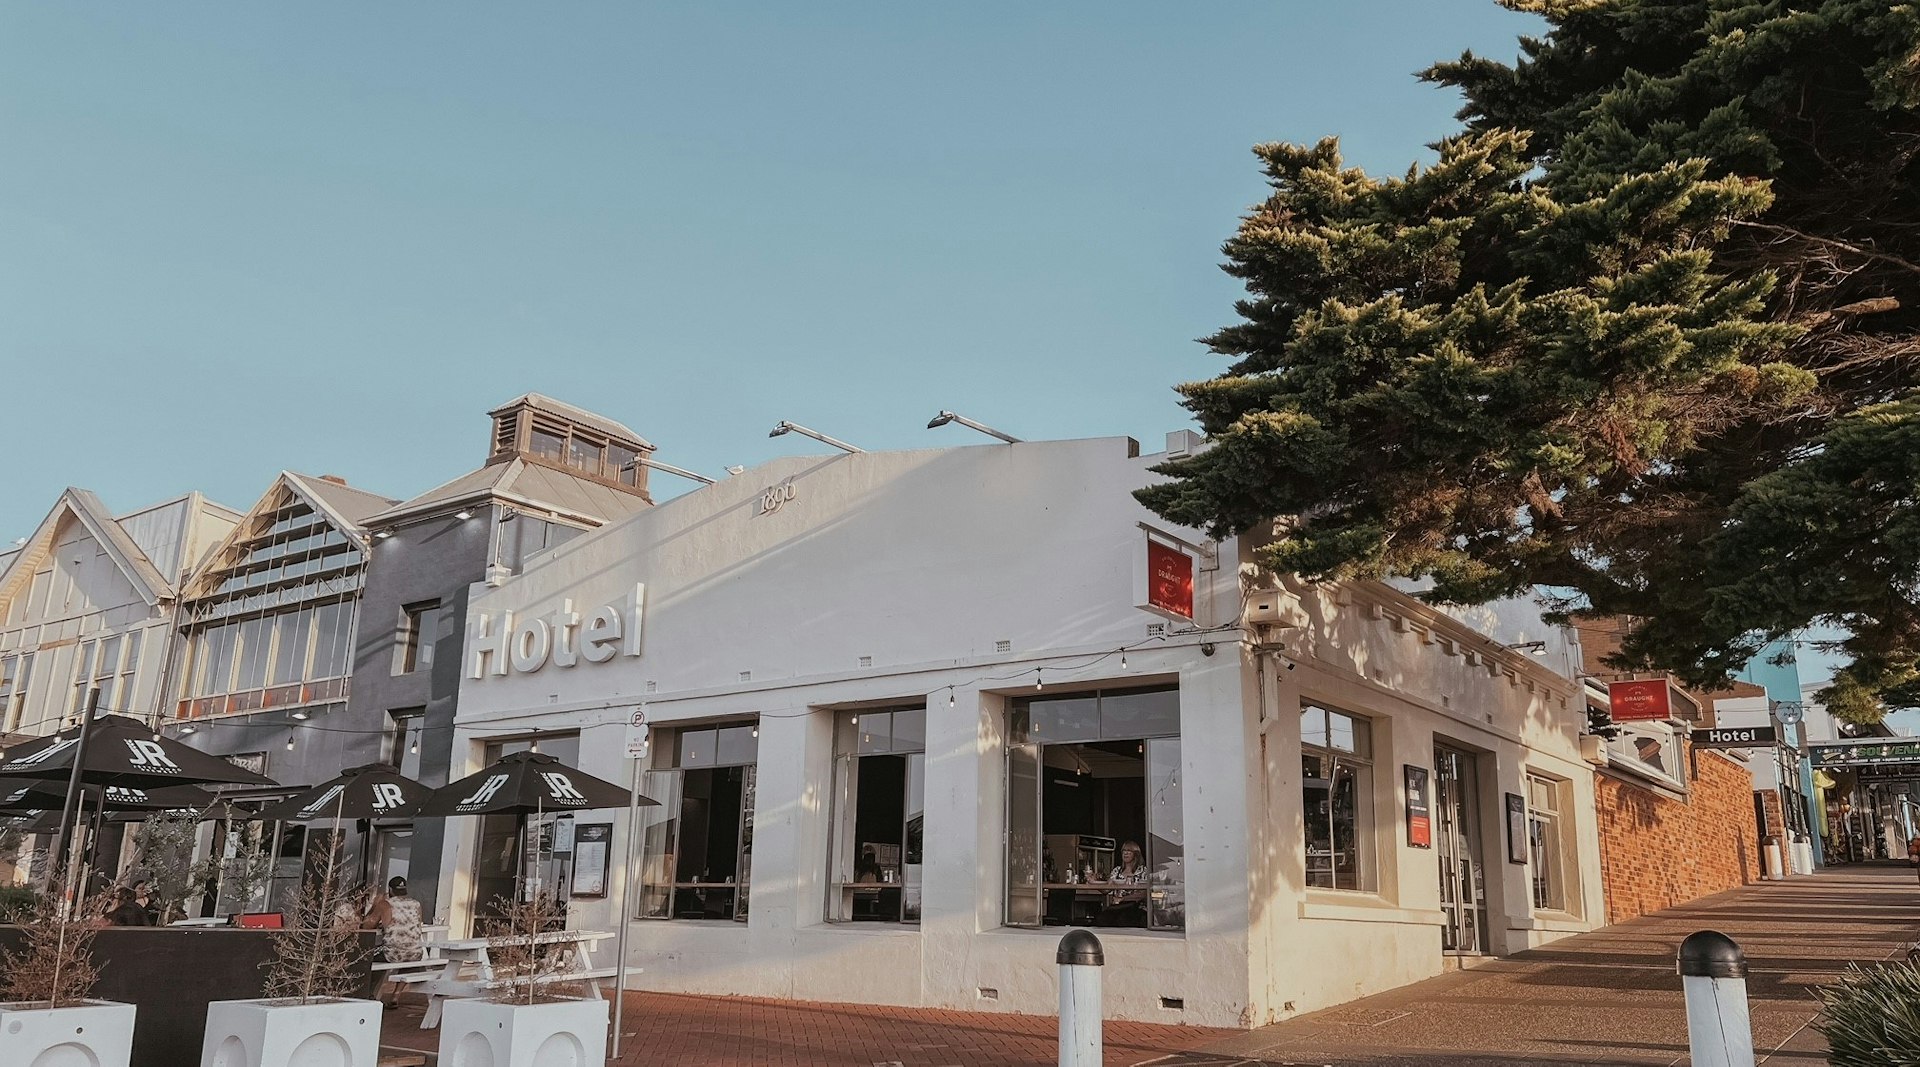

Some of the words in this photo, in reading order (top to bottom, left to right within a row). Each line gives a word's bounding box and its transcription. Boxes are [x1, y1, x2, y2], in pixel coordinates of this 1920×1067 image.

[466, 582, 645, 679] Hotel
[1709, 729, 1756, 742] Hotel
[123, 738, 178, 768] JR
[1856, 744, 1920, 757] SOUVENI
[371, 783, 406, 809] JR
[460, 774, 510, 805] JR
[540, 772, 585, 799] JR
